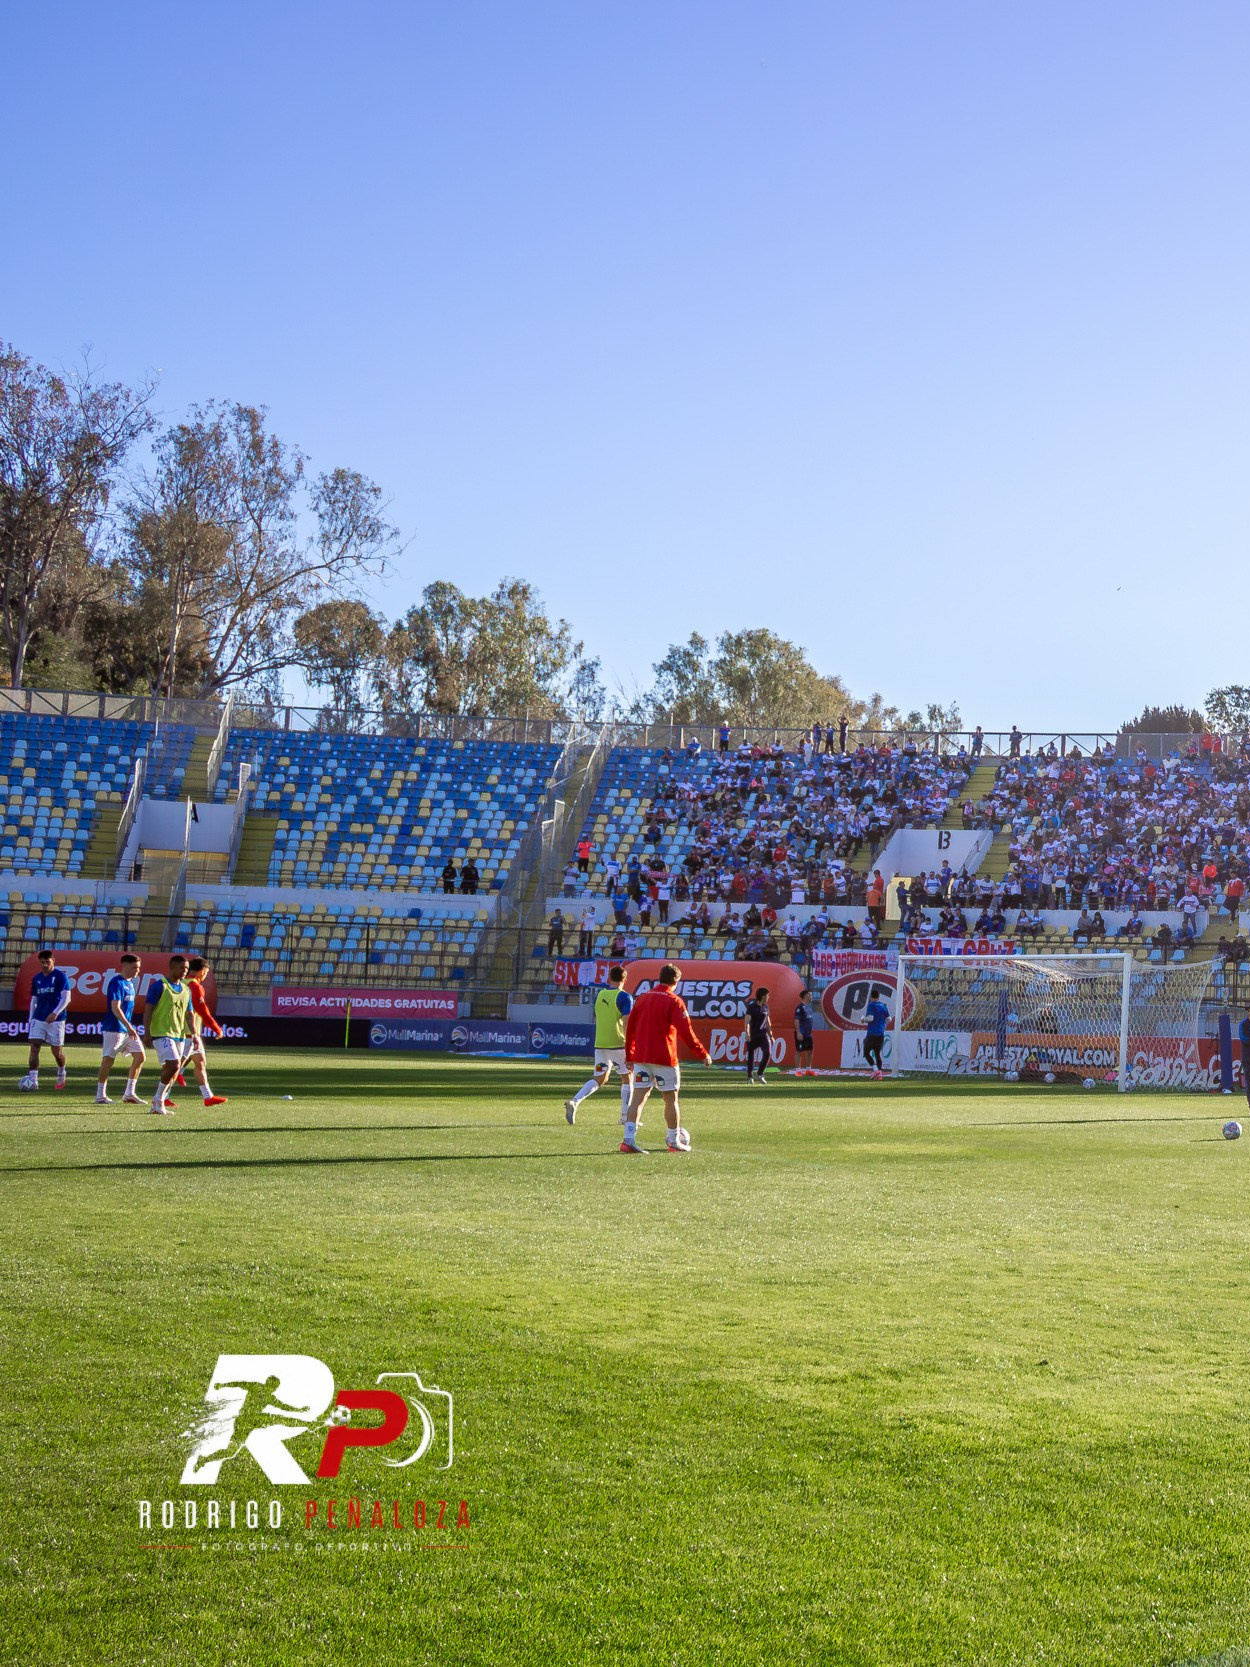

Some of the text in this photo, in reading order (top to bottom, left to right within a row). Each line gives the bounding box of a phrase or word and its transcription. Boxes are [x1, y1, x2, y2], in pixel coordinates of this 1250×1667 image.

[938, 831, 951, 849] B
[277, 996, 454, 1010] REVISA ACTIVIDADES GRATUITAS
